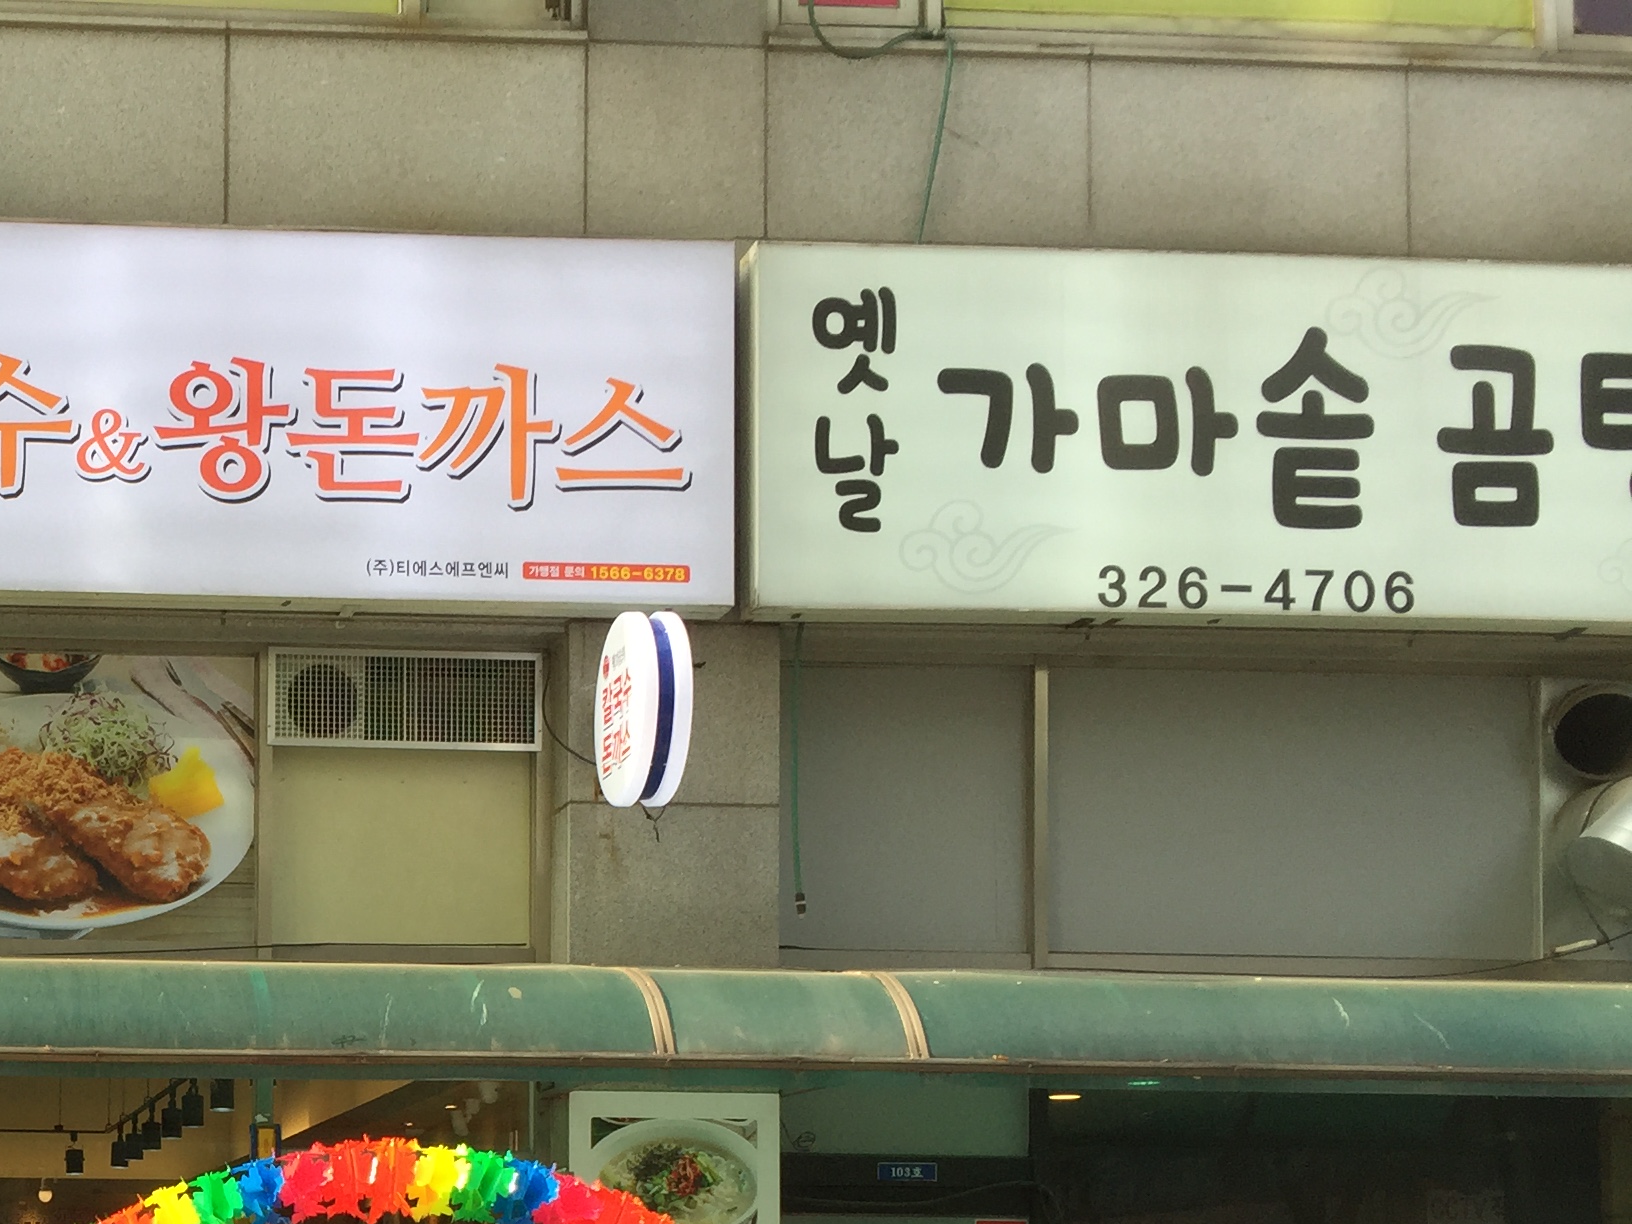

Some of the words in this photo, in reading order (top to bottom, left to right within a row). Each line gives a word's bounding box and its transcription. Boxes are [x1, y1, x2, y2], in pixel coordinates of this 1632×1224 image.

[811, 286, 899, 533] 옛날
[937, 326, 1375, 530] 가마솥
[365, 558, 510, 581] (주)티에스에프엔씨
[528, 564, 560, 578] 가맹점
[563, 564, 586, 579] 문의
[590, 565, 687, 583] 1566-6378
[1097, 565, 1416, 614] 326-4706
[891, 1166, 924, 1178] 103호
